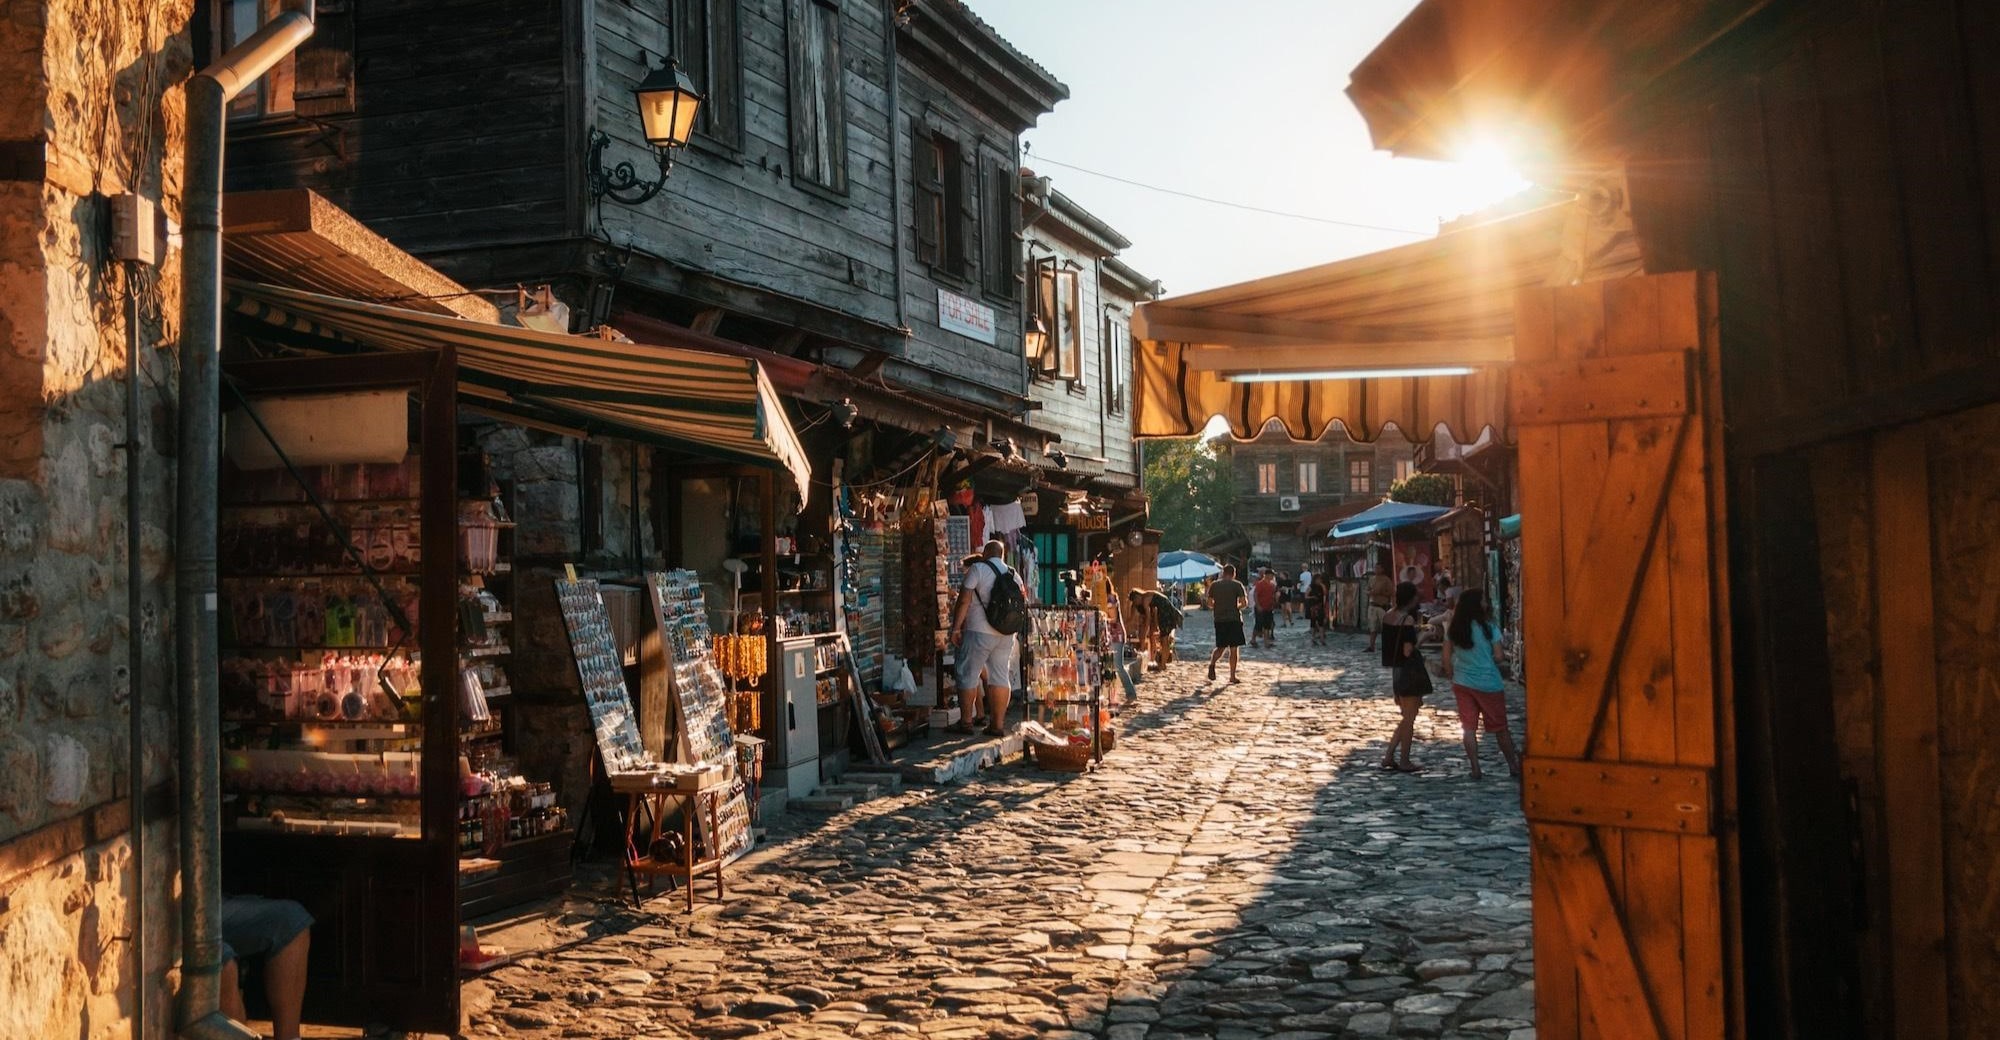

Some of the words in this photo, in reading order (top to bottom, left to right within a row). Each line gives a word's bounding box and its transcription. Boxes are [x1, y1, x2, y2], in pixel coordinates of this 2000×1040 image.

[942, 290, 962, 321] FOR
[965, 300, 990, 332] SALE
[1077, 514, 1107, 530] HOUSE
